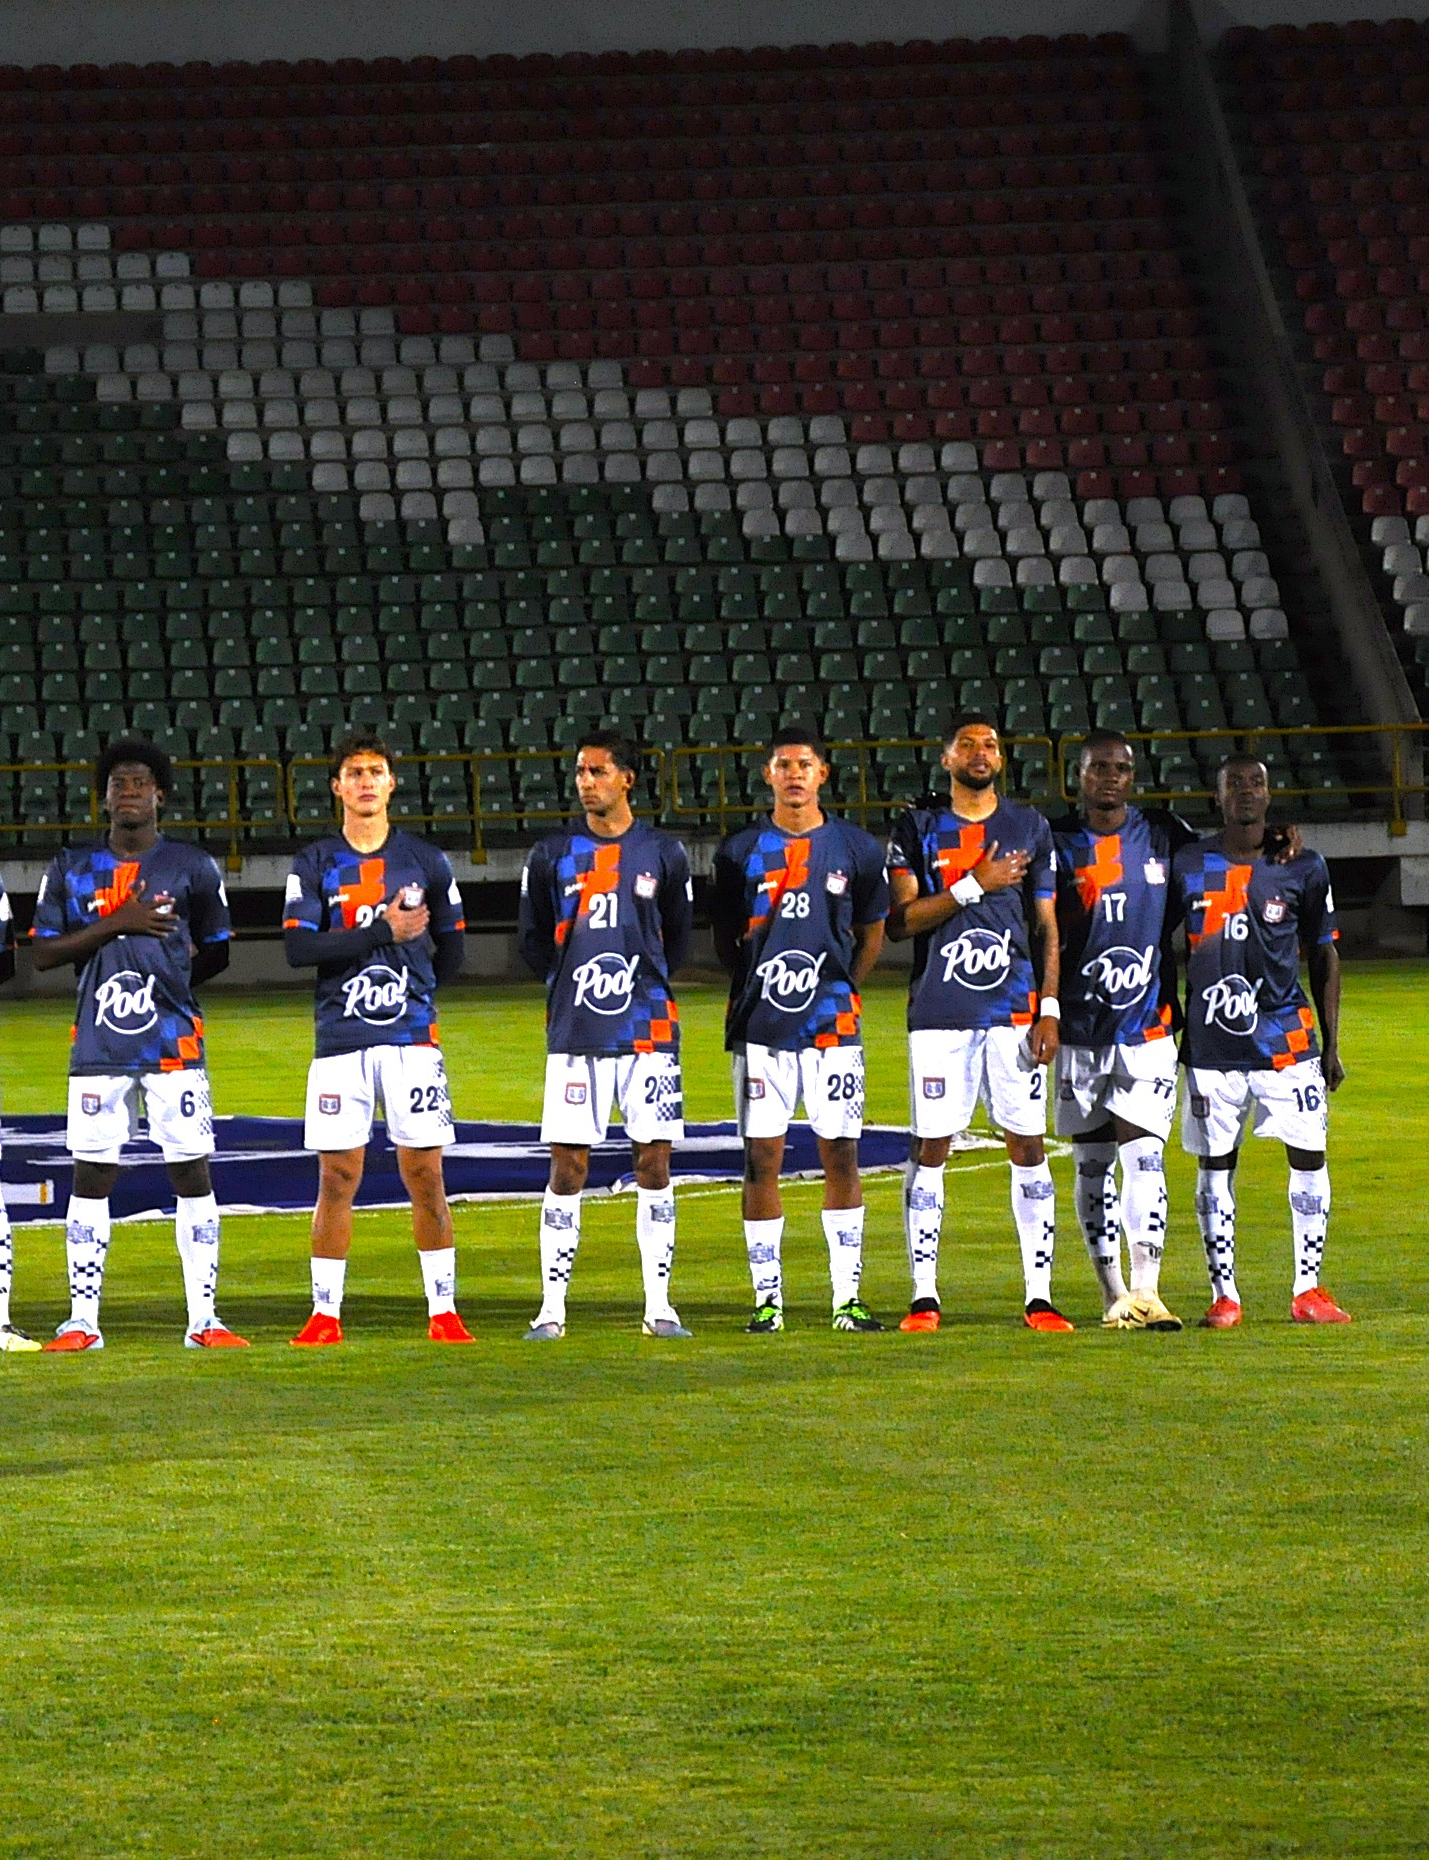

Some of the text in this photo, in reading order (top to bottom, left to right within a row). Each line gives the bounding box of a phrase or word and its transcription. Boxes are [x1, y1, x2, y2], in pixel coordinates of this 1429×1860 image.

[589, 892, 618, 929] 21
[781, 891, 810, 918] 28
[1102, 892, 1127, 922] 17
[1222, 912, 1249, 940] 16
[940, 930, 1011, 980] Pool
[1082, 945, 1154, 1000] Pool
[341, 966, 408, 1016] Pool
[573, 954, 640, 1006] Pool
[756, 952, 828, 1004] Pool
[95, 970, 156, 1026] Pool
[1202, 977, 1263, 1025] Pool
[180, 1090, 195, 1117] 6
[410, 1087, 439, 1113] 22
[828, 1074, 855, 1100] 28
[1292, 1085, 1320, 1113] 16
